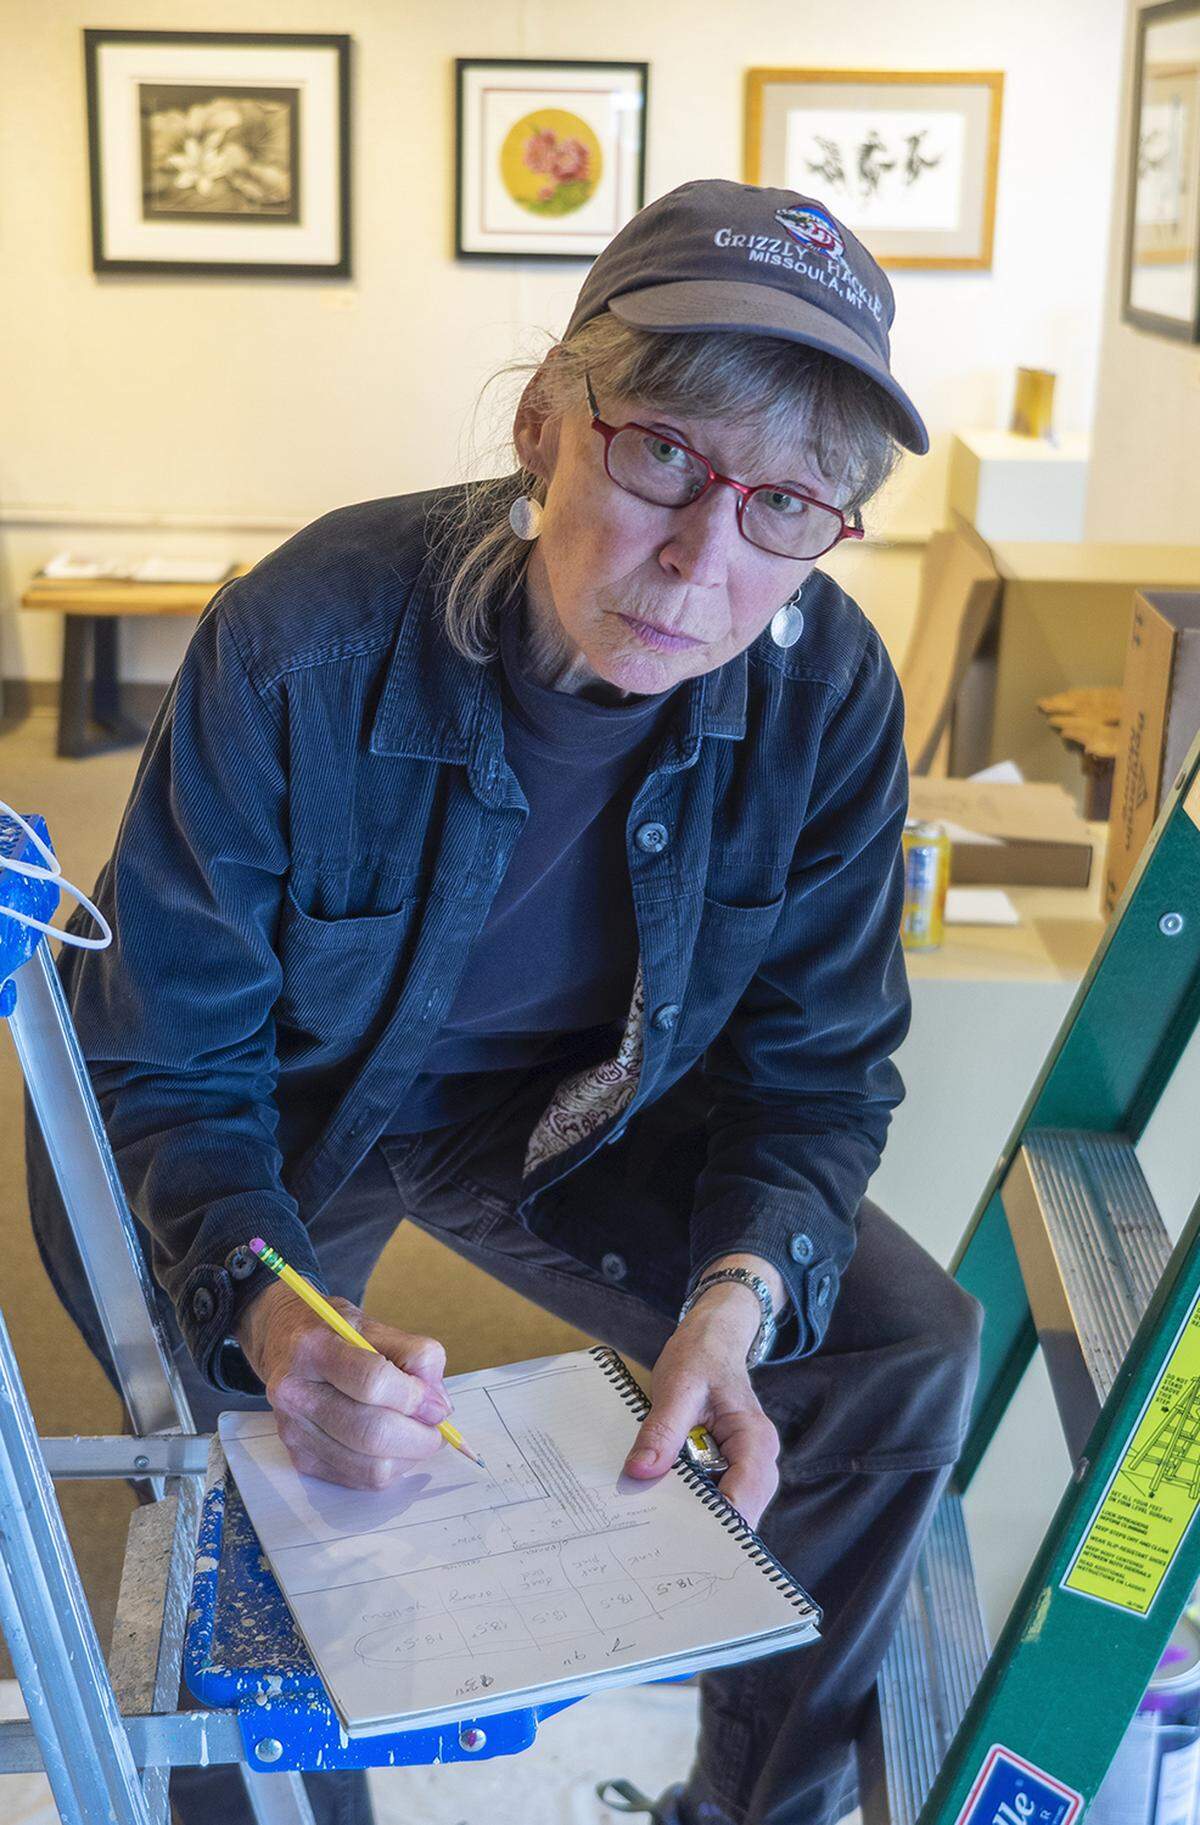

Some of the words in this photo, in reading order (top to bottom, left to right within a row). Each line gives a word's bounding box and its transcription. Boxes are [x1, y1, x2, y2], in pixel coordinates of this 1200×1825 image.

[714, 228, 808, 260] GRIZZLY
[827, 259, 883, 322] HACKLE
[749, 250, 843, 298] MISSOULA,
[846, 287, 864, 310] MT
[1131, 1504, 1148, 1514] LEVEL
[1148, 1510, 1173, 1523] SURFACE
[1095, 1524, 1109, 1532] KEEP
[1110, 1530, 1126, 1539] STEPS
[1139, 1540, 1151, 1548] AND
[1151, 1545, 1169, 1554] CLEAN
[654, 1576, 694, 1596] 18.5
